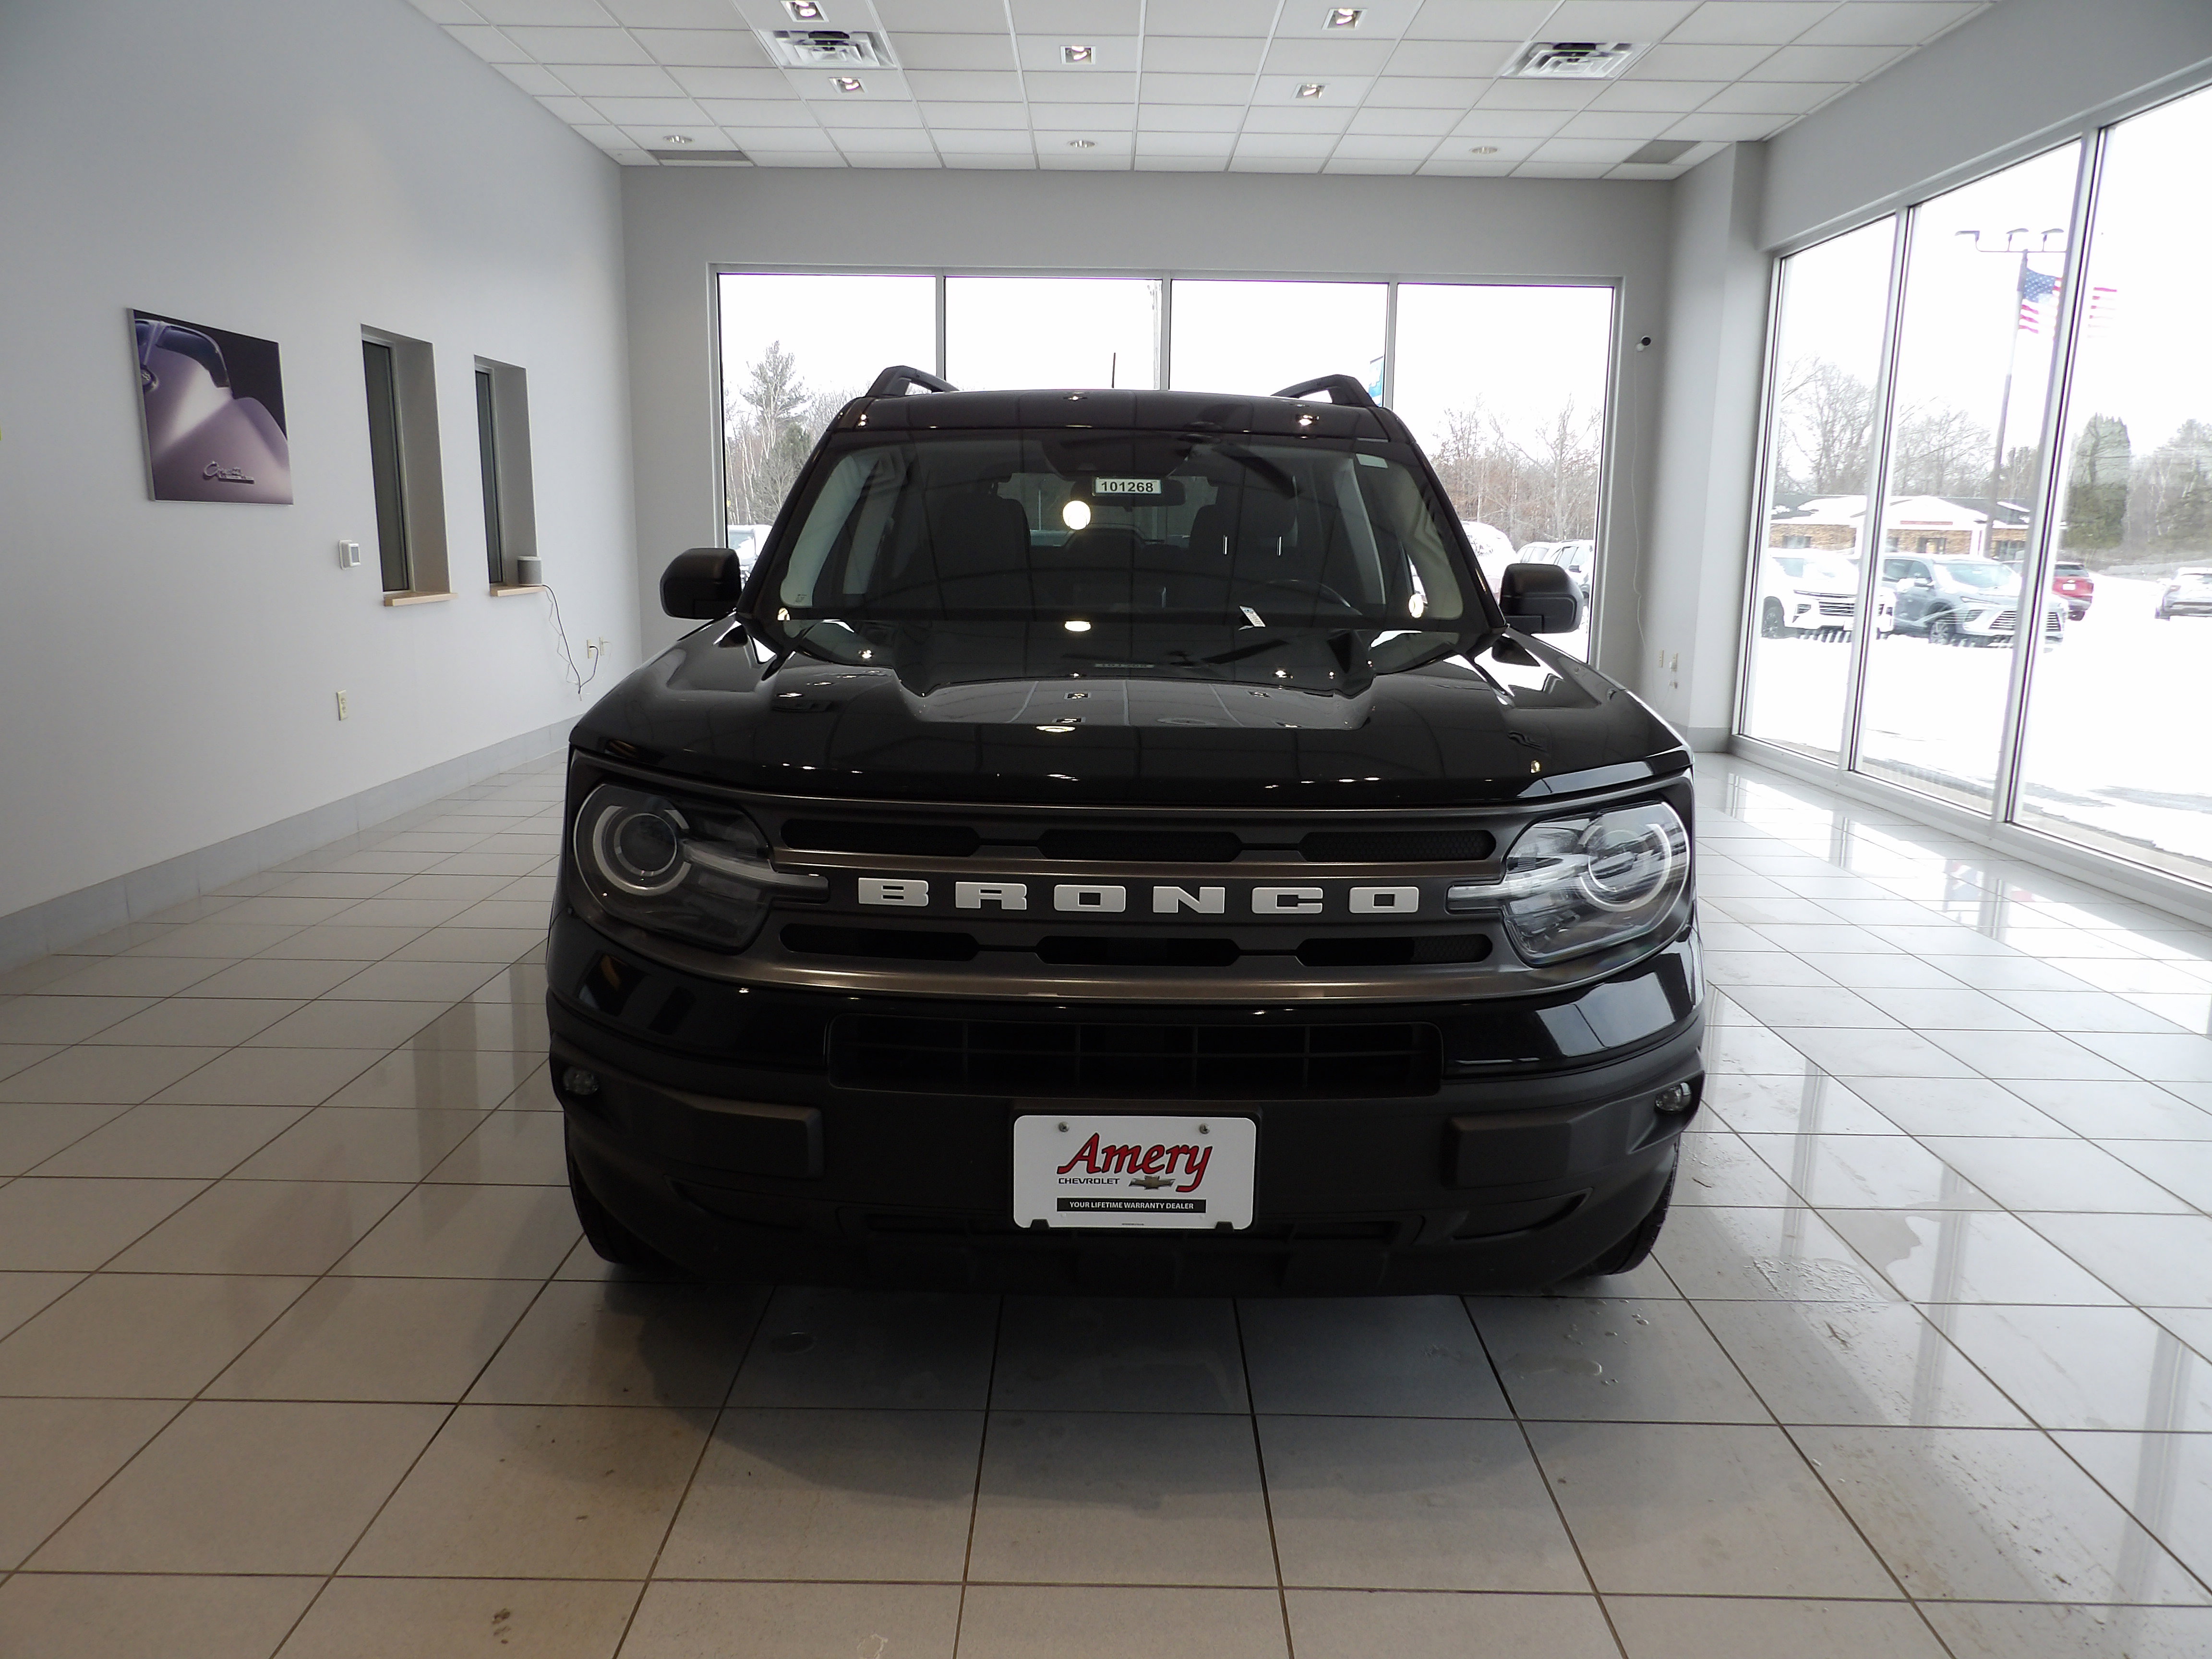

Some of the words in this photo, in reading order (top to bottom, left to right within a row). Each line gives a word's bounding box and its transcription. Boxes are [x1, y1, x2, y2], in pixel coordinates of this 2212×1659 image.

[1101, 481, 1153, 492] 101268
[858, 878, 1419, 914] BRONCO
[1057, 1132, 1213, 1192] Amery
